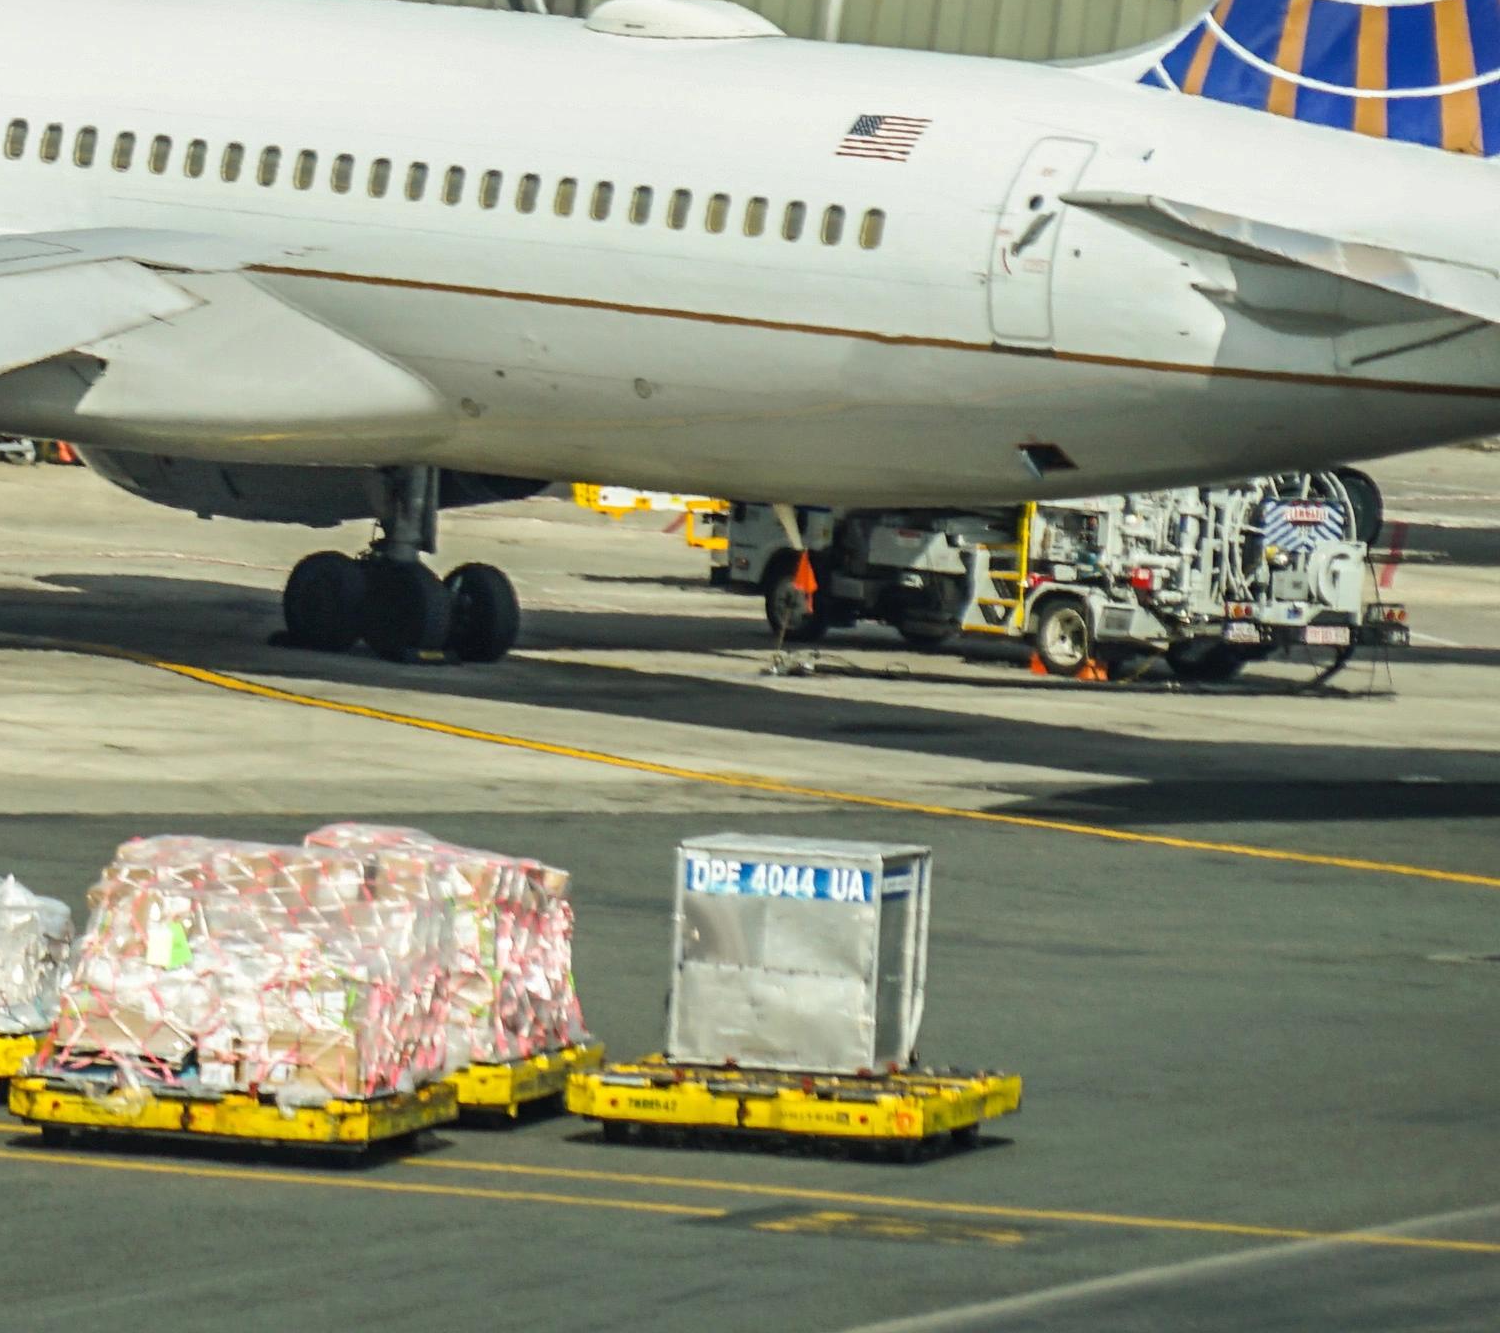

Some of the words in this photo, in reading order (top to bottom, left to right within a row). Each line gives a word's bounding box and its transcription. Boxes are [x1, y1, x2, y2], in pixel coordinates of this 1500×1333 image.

[692, 859, 742, 894] DPE
[750, 863, 816, 900] 4044
[830, 868, 866, 903] UA
